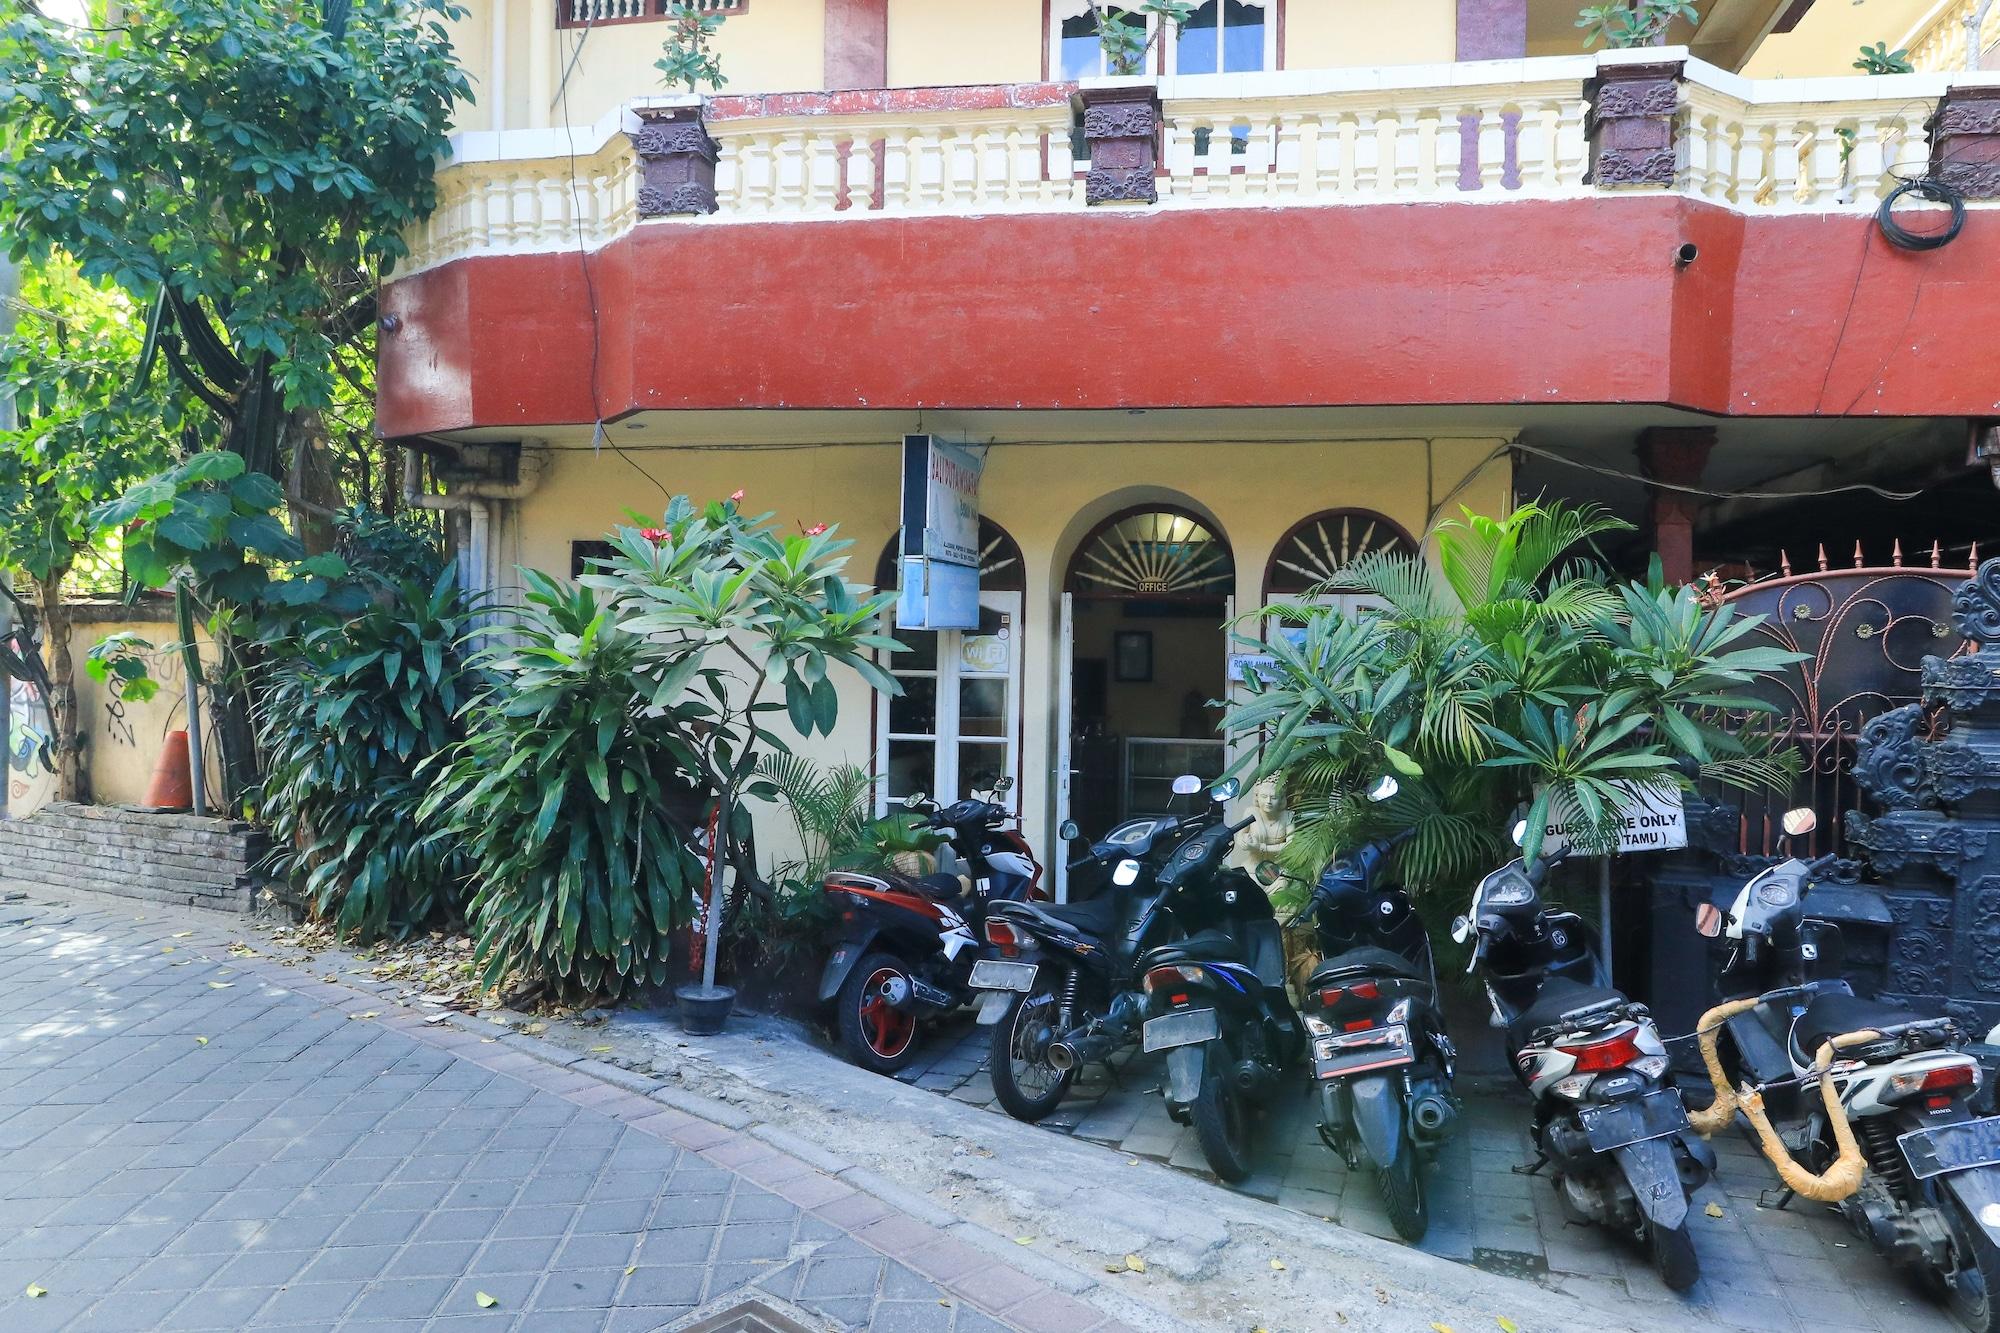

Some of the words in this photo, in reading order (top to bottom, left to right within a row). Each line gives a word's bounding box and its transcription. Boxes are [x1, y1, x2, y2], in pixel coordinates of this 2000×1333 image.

[1138, 582, 1168, 592] OFFICE
[1640, 813, 1677, 828] ONLY
[1929, 1108, 1952, 1116] HONDA
